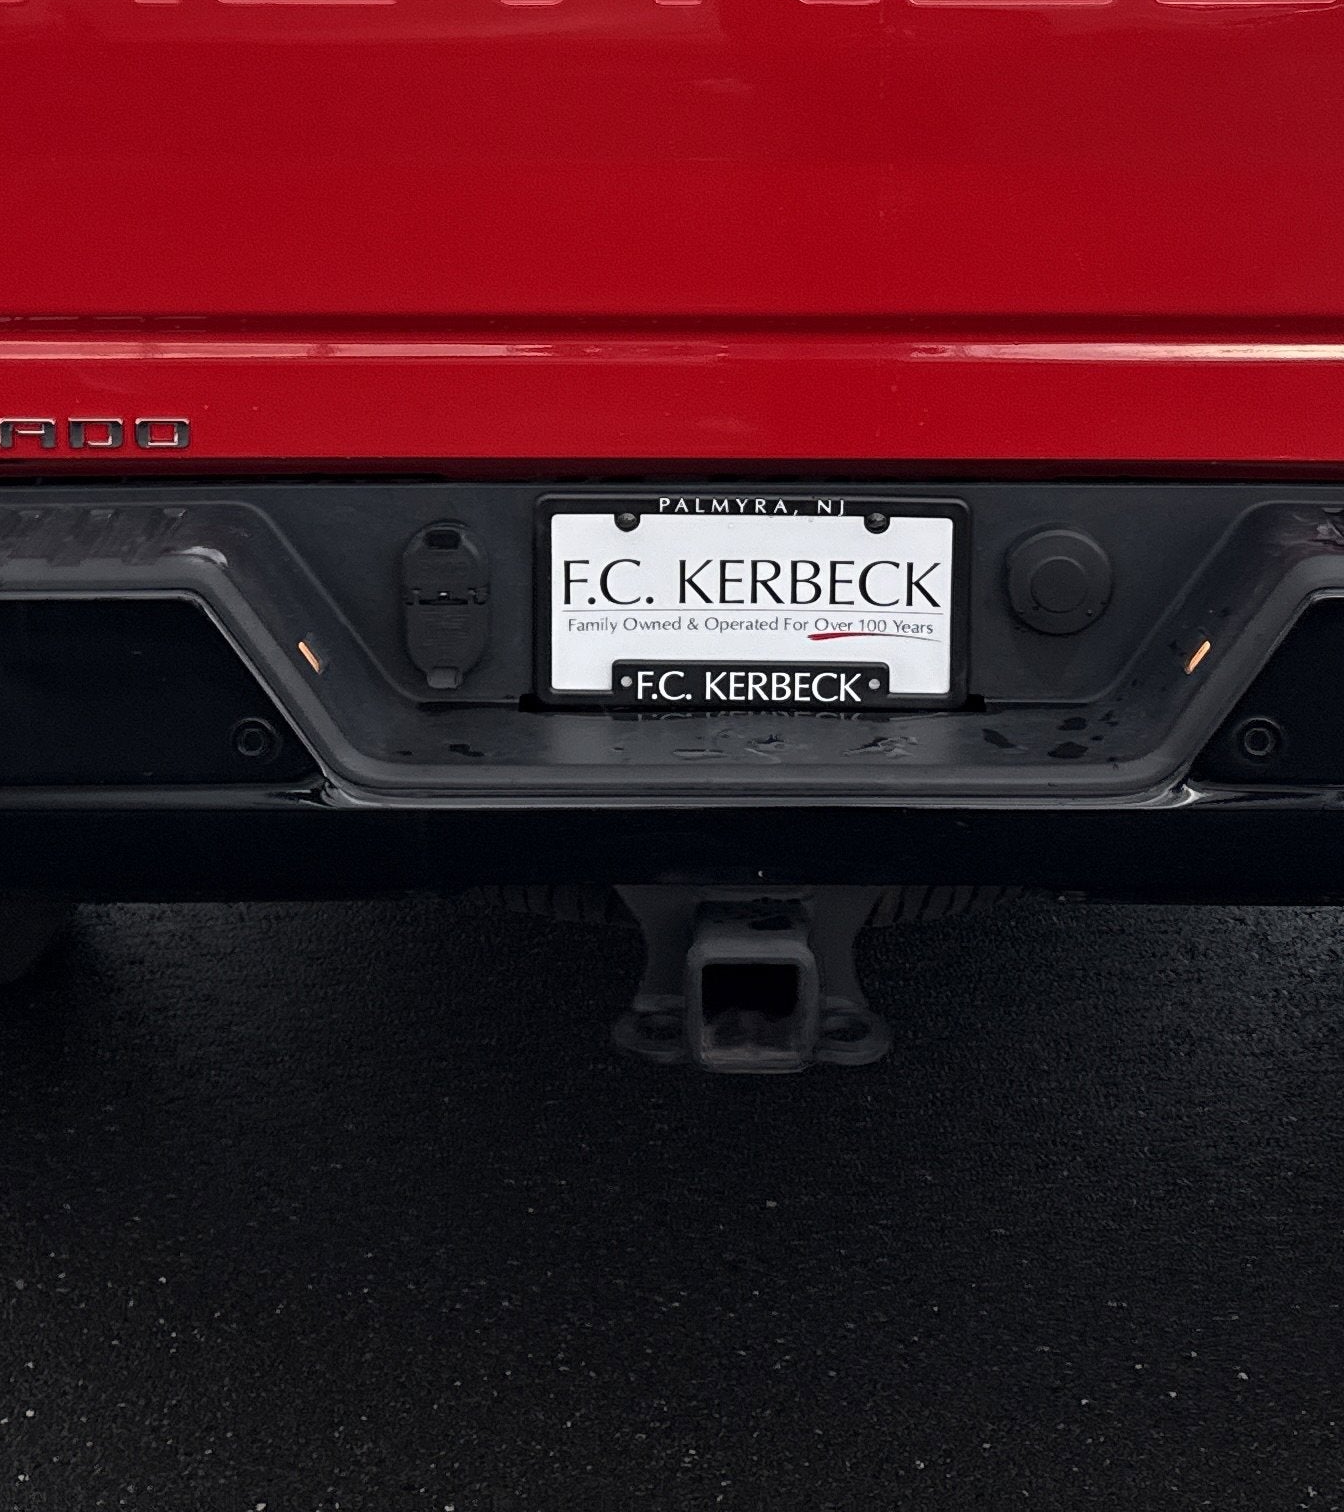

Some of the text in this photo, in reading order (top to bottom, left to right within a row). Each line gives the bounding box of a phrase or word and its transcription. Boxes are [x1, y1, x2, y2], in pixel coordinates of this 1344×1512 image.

[659, 497, 845, 517] PALMYRA, NJ
[563, 559, 942, 608] F.C. KERBECK
[567, 617, 934, 635] Family Owned & Operated For Over 100 Years
[636, 671, 862, 703] F.C. KERBECK
